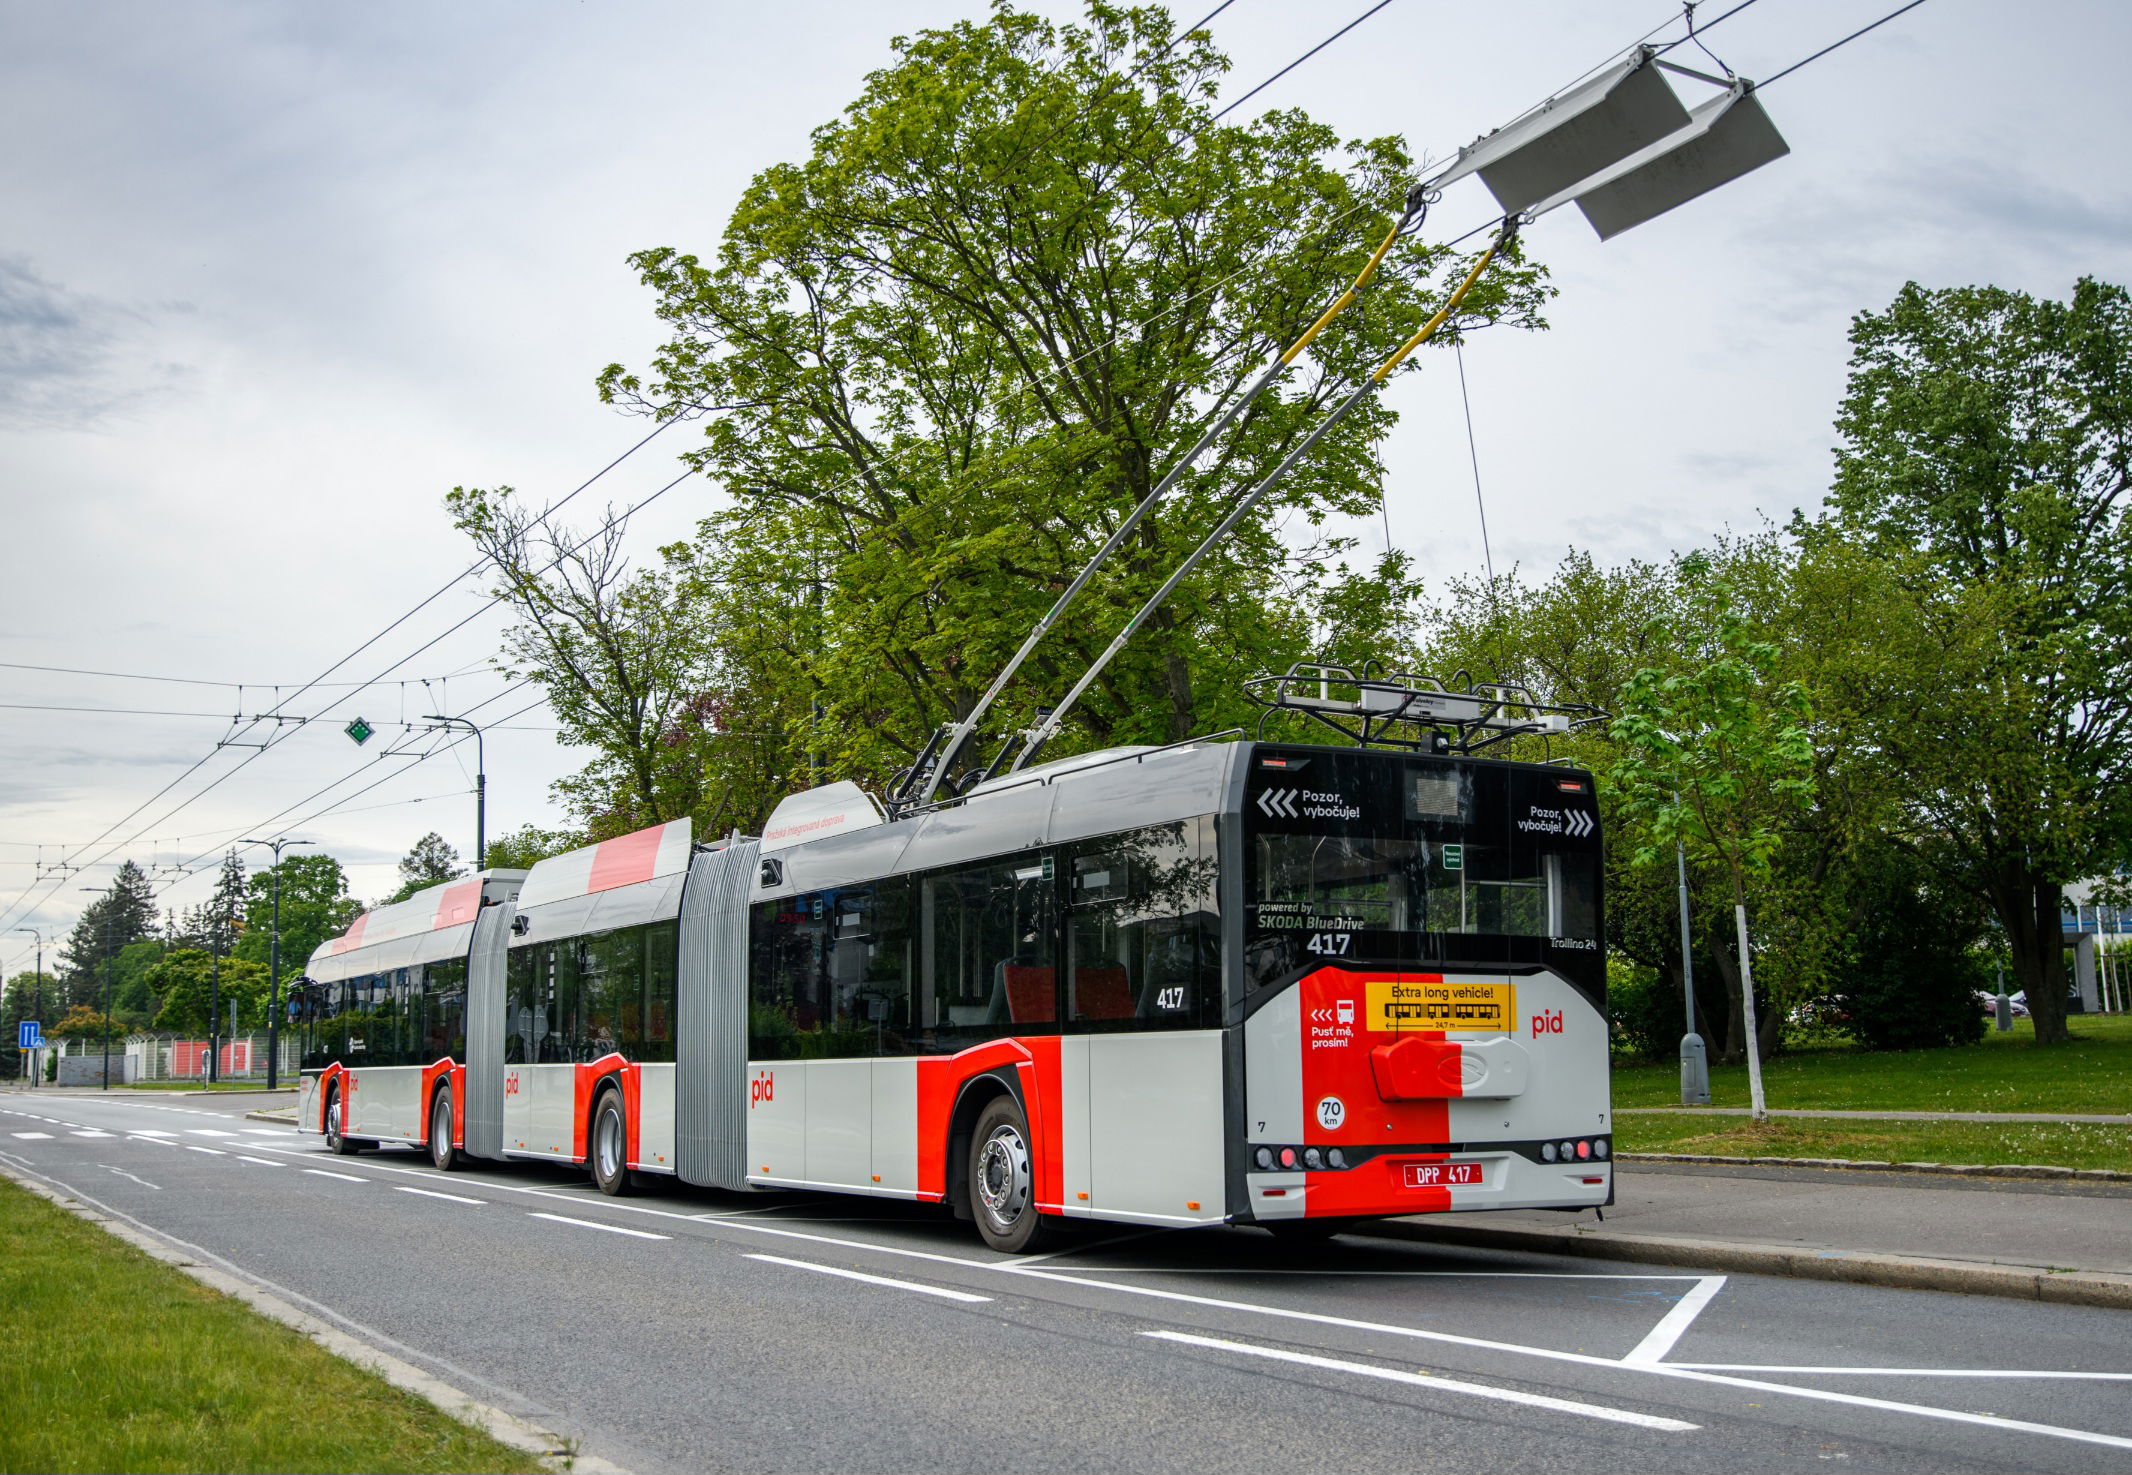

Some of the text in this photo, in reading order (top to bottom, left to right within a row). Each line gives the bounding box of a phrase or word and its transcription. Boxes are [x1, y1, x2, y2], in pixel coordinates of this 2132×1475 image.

[1302, 790, 1343, 805] Pozor,
[1303, 804, 1360, 820] vybočuje!
[1530, 805, 1561, 821] Pozor,
[1517, 819, 1562, 834] vybočuje!
[1258, 902, 1313, 915] powered by
[1306, 916, 1365, 930] BlueDrive
[1306, 933, 1351, 955] 417
[1550, 937, 1597, 950] Trollino 24
[1157, 986, 1184, 1009] 417
[1391, 986, 1494, 1001] Extra long vehicle!
[1311, 1025, 1354, 1038] Pusť mě,
[1435, 1021, 1448, 1029] 24,7
[1532, 1008, 1563, 1040] pid
[1311, 1037, 1348, 1050] prosím!
[506, 1071, 519, 1100] pid
[751, 1070, 773, 1109] pid
[1321, 1101, 1341, 1116] 70
[1324, 1116, 1338, 1125] km
[1599, 1113, 1605, 1124] 7
[1258, 1121, 1266, 1133] 7
[1416, 1165, 1471, 1185] DPP 417
